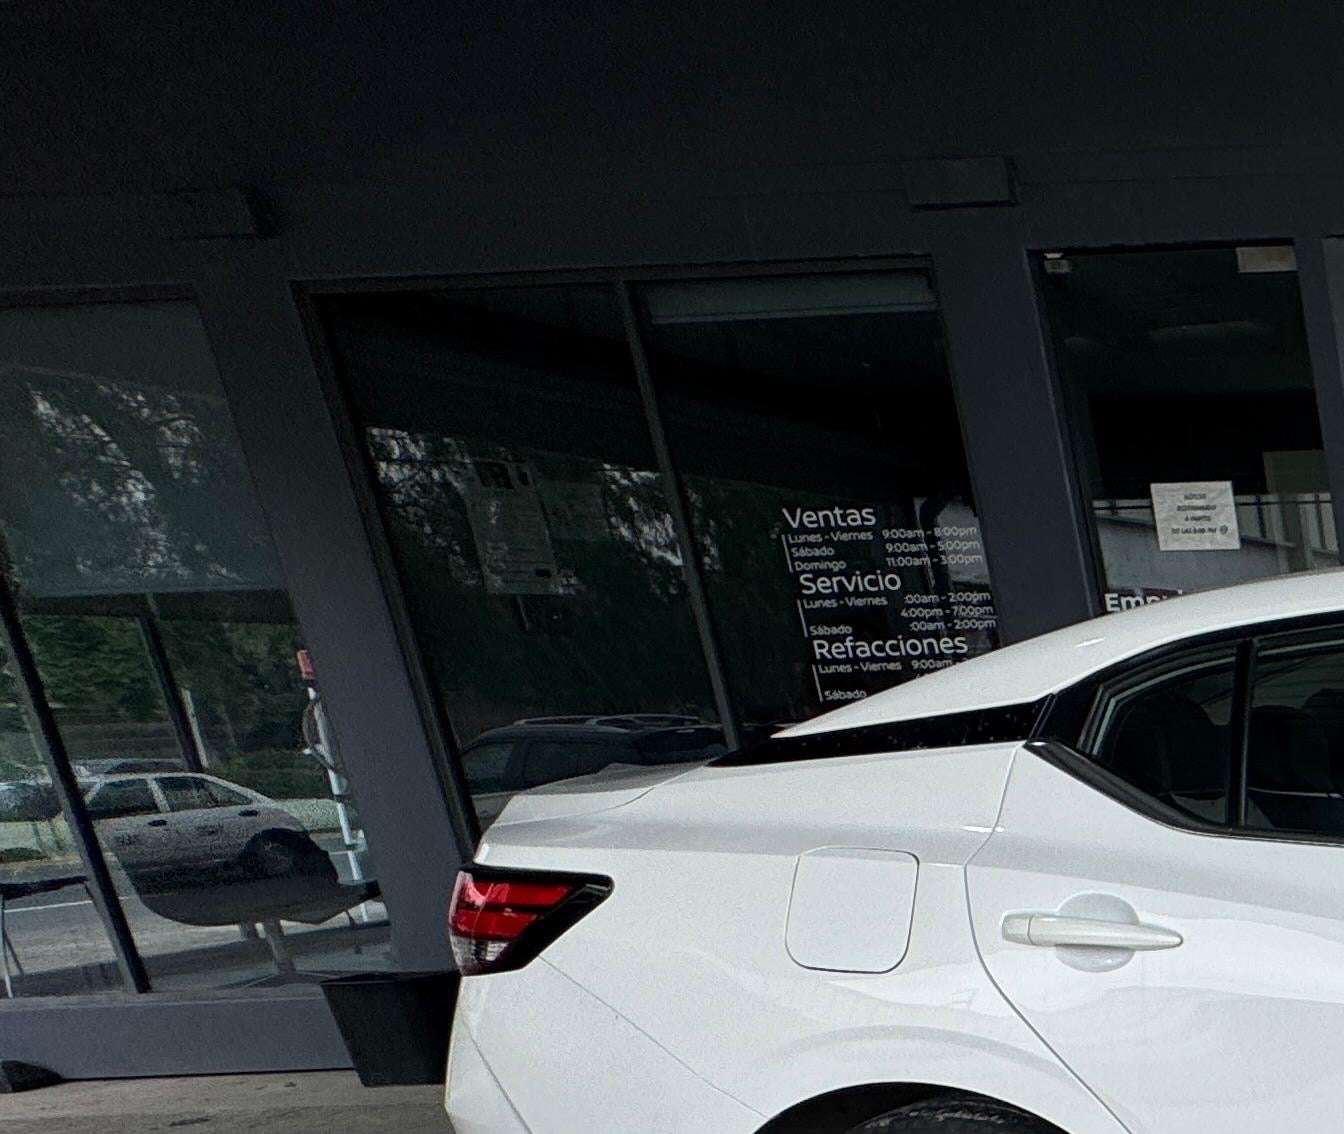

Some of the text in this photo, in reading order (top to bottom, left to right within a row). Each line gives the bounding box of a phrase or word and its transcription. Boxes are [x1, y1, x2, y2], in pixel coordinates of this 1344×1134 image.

[782, 506, 877, 528] Ventas
[788, 533, 823, 544] Lunes
[830, 530, 874, 542] Viernes
[881, 527, 925, 539] 9:00am
[791, 545, 836, 558] Sábado
[885, 541, 928, 553] 9:00am
[794, 559, 847, 572] Domingo
[799, 569, 902, 595] Servicio
[803, 598, 838, 609] Lunes
[844, 595, 889, 607] Viernes
[900, 606, 944, 619] 4:00pm
[809, 624, 853, 637] Sábado
[812, 635, 969, 660] Refacciones
[817, 663, 853, 674] Lunes
[860, 661, 902, 672] Viernes
[824, 688, 867, 701] Sábado
